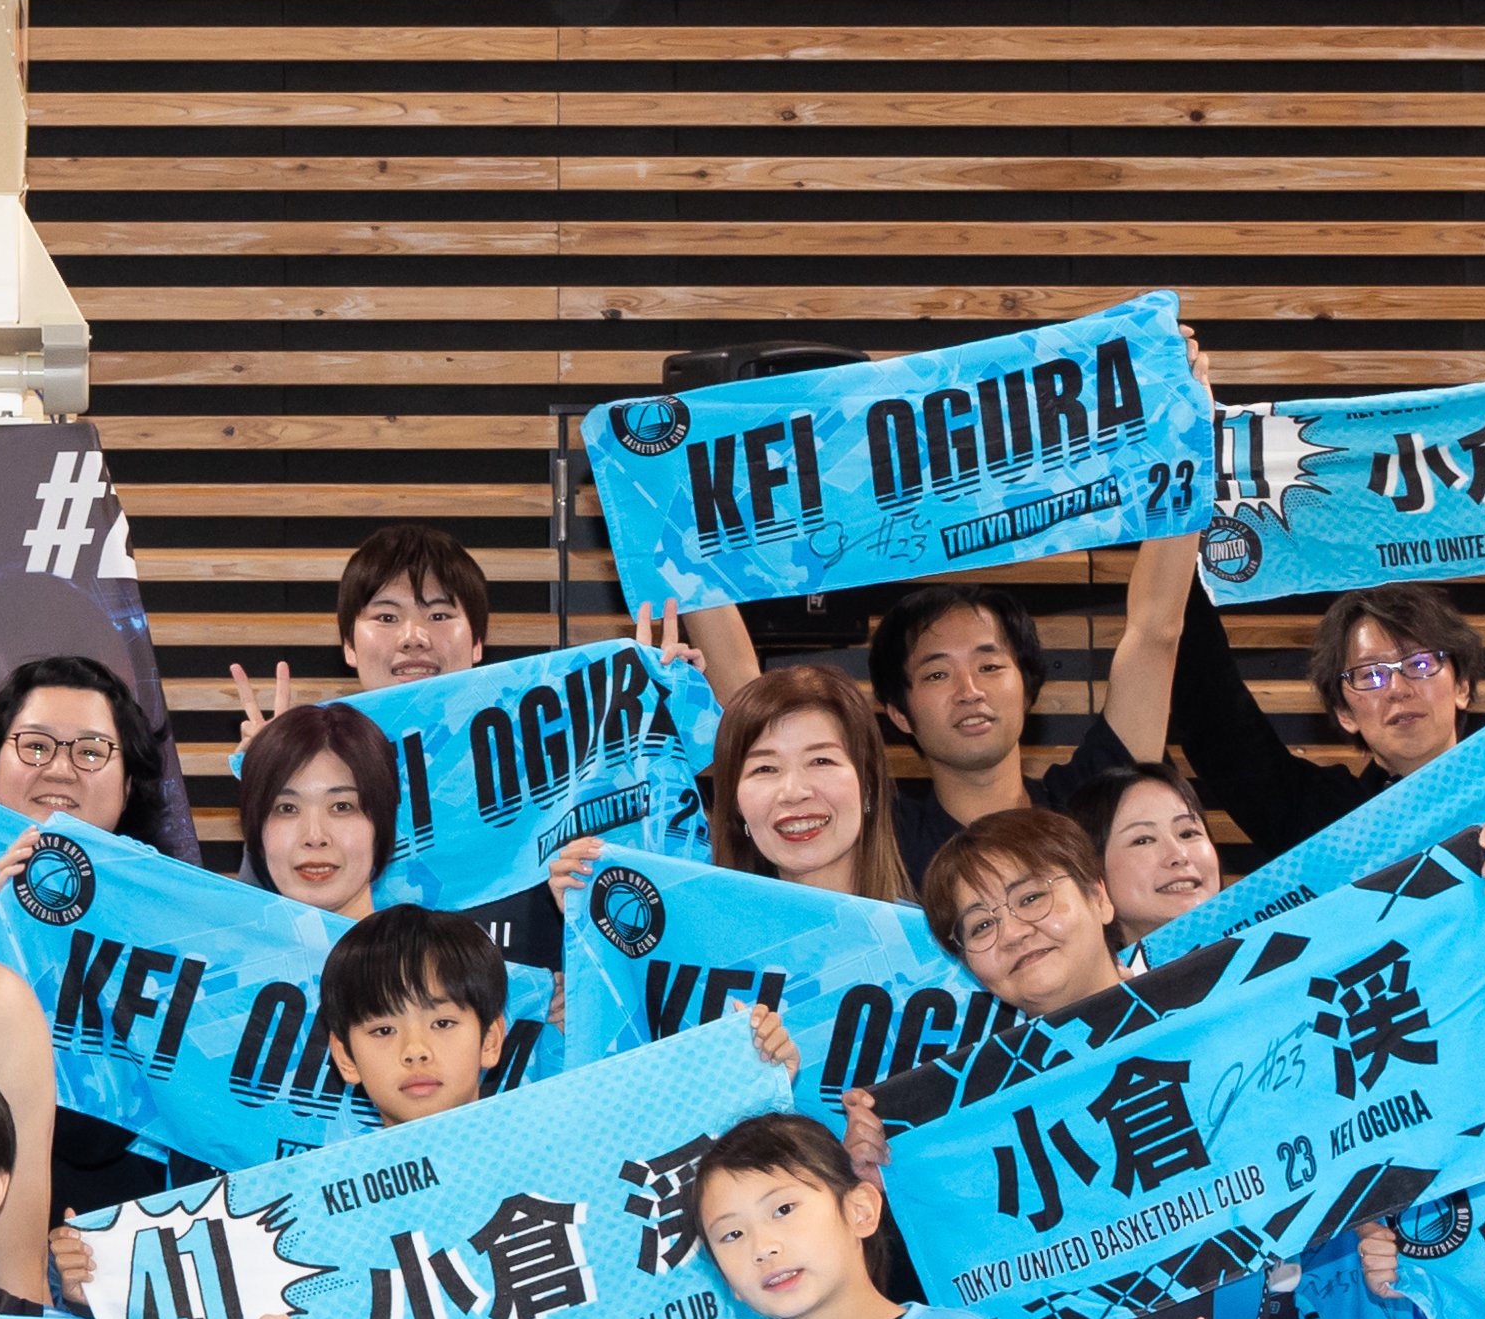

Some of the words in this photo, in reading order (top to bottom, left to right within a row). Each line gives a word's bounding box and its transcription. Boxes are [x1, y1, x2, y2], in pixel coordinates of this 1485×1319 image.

[864, 335, 1151, 518] OGURA
[944, 522, 1011, 560] TOKYO
[1012, 488, 1089, 542] UNITED
[1090, 476, 1122, 511] BC
[1145, 460, 1195, 520] 23
[1209, 538, 1247, 562] UNITED
[1375, 539, 1432, 570] TOKYO
[62, 839, 92, 878] UNITED
[17, 883, 61, 924] BASKETBALL
[62, 904, 83, 922] CLUB
[993, 1056, 1212, 1234] 小倉
[1309, 938, 1439, 1101] 渓
[322, 1178, 363, 1217] KEI
[362, 1155, 441, 1206] OGURA
[951, 1257, 1015, 1308] TOKYO
[1016, 1229, 1090, 1285] UNITED
[1089, 1188, 1215, 1261] BASKETBALL
[1215, 1164, 1267, 1207] CLUB
[1277, 1135, 1317, 1193] 23
[1330, 1121, 1359, 1162] KEI
[1358, 1088, 1432, 1143] OGURA
[1402, 1232, 1464, 1256] BASKETBALL
[1456, 1207, 1470, 1233] CLUB
